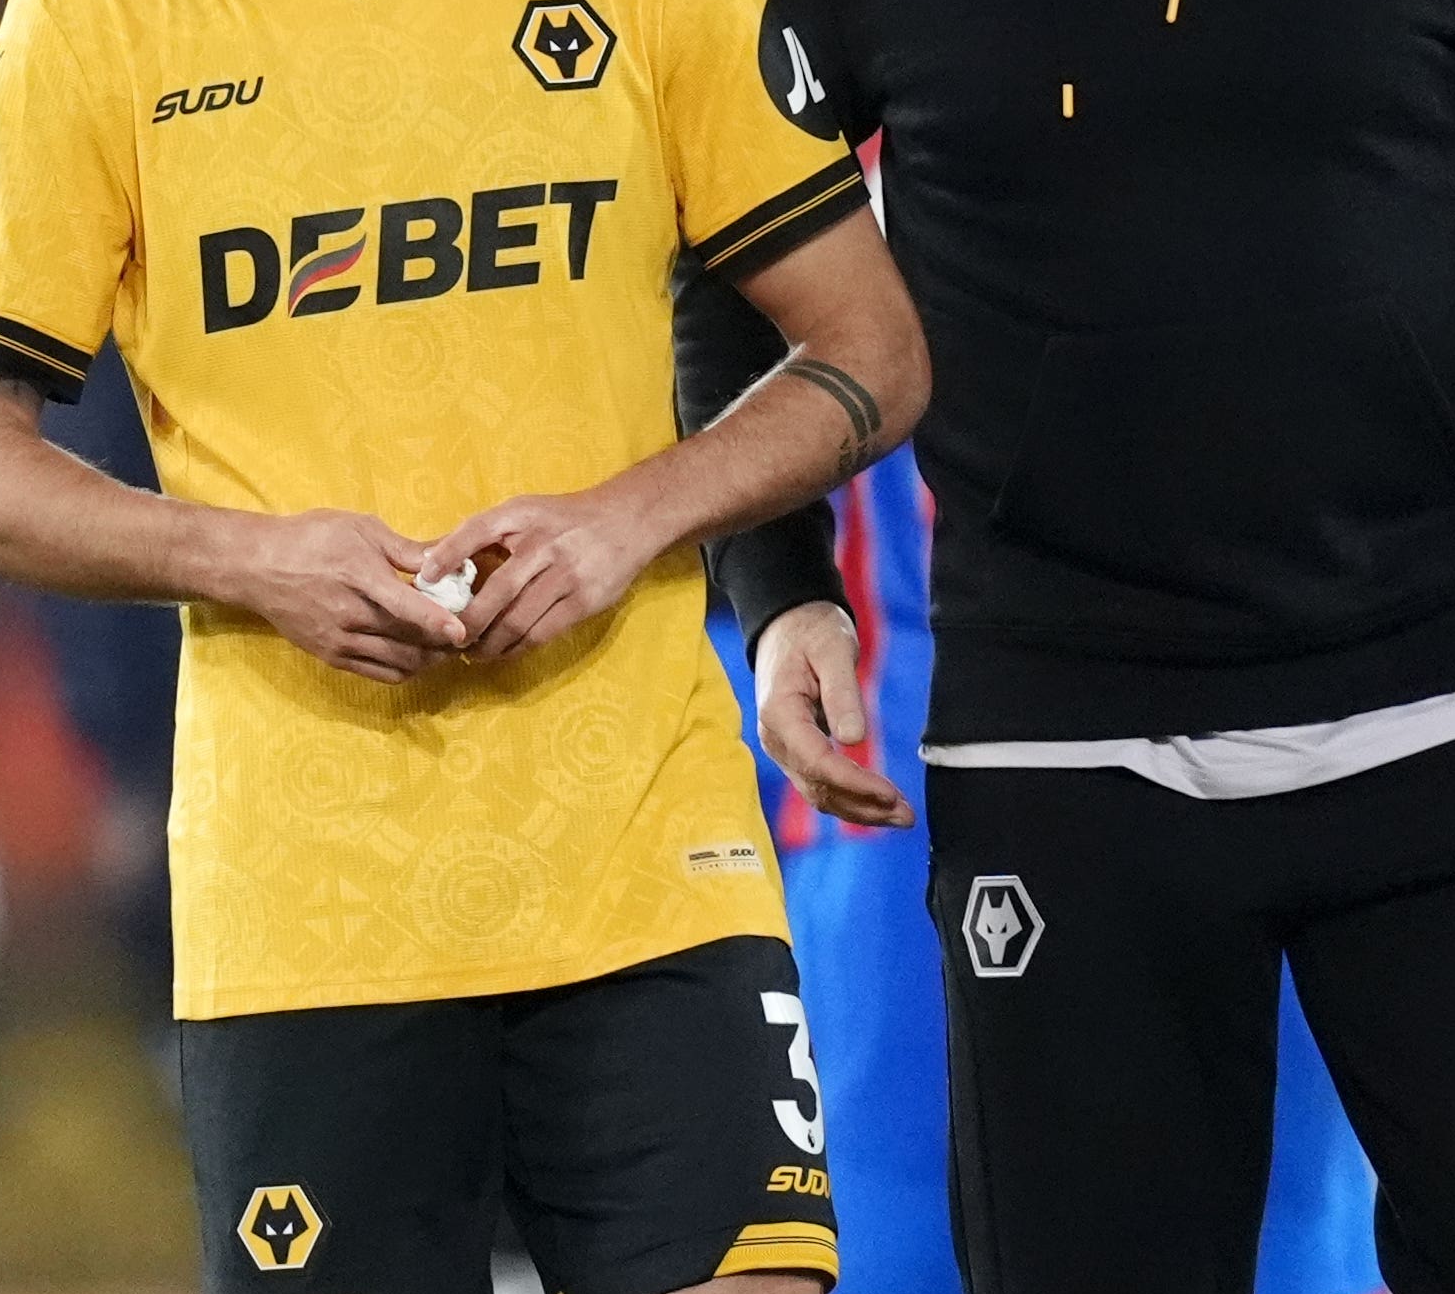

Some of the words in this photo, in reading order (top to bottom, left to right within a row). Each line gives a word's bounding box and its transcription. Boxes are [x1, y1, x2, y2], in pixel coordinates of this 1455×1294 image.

[151, 76, 264, 124] SUDU
[199, 179, 619, 335] DEBET
[759, 990, 825, 1156] 3
